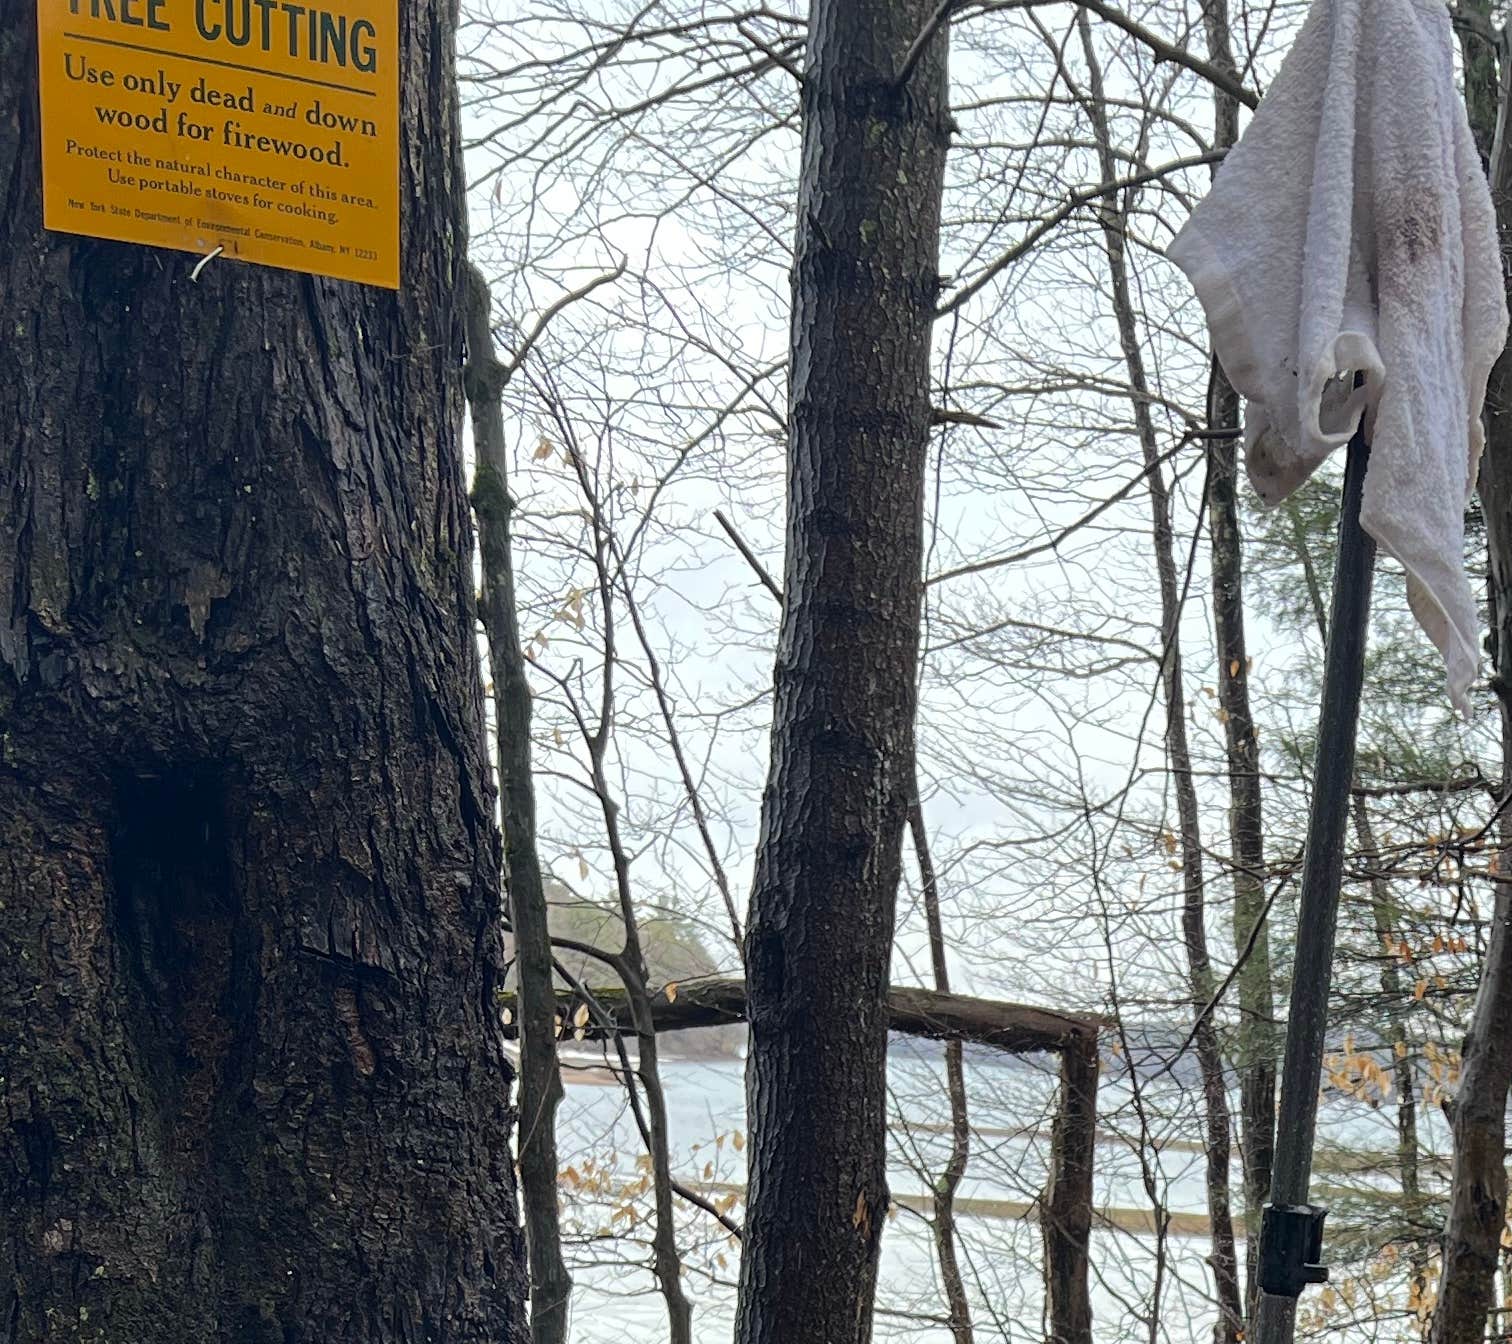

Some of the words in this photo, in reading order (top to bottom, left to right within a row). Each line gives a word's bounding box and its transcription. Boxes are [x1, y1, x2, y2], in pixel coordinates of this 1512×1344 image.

[195, 0, 376, 73] CUTTING
[64, 53, 115, 86] Use
[123, 70, 181, 103] only
[190, 77, 254, 113] dead
[262, 102, 298, 119] and
[305, 100, 377, 137] down
[95, 107, 168, 134] wood
[177, 112, 214, 141] for
[223, 120, 350, 168] firewood.
[66, 139, 122, 162] Protect
[127, 150, 151, 166] the
[155, 158, 211, 177] natural
[215, 165, 286, 190] character
[290, 180, 305, 195] of
[309, 183, 338, 201] this
[341, 193, 378, 209] area.
[107, 168, 136, 186] Use
[139, 178, 202, 197] portable
[205, 190, 250, 205] stoves
[253, 193, 273, 209] for
[276, 202, 339, 225] cooking.
[68, 199, 85, 209] New
[90, 202, 105, 213] York
[111, 205, 131, 217] State
[134, 209, 181, 225] Department
[184, 218, 193, 228] of
[339, 245, 351, 255] NY
